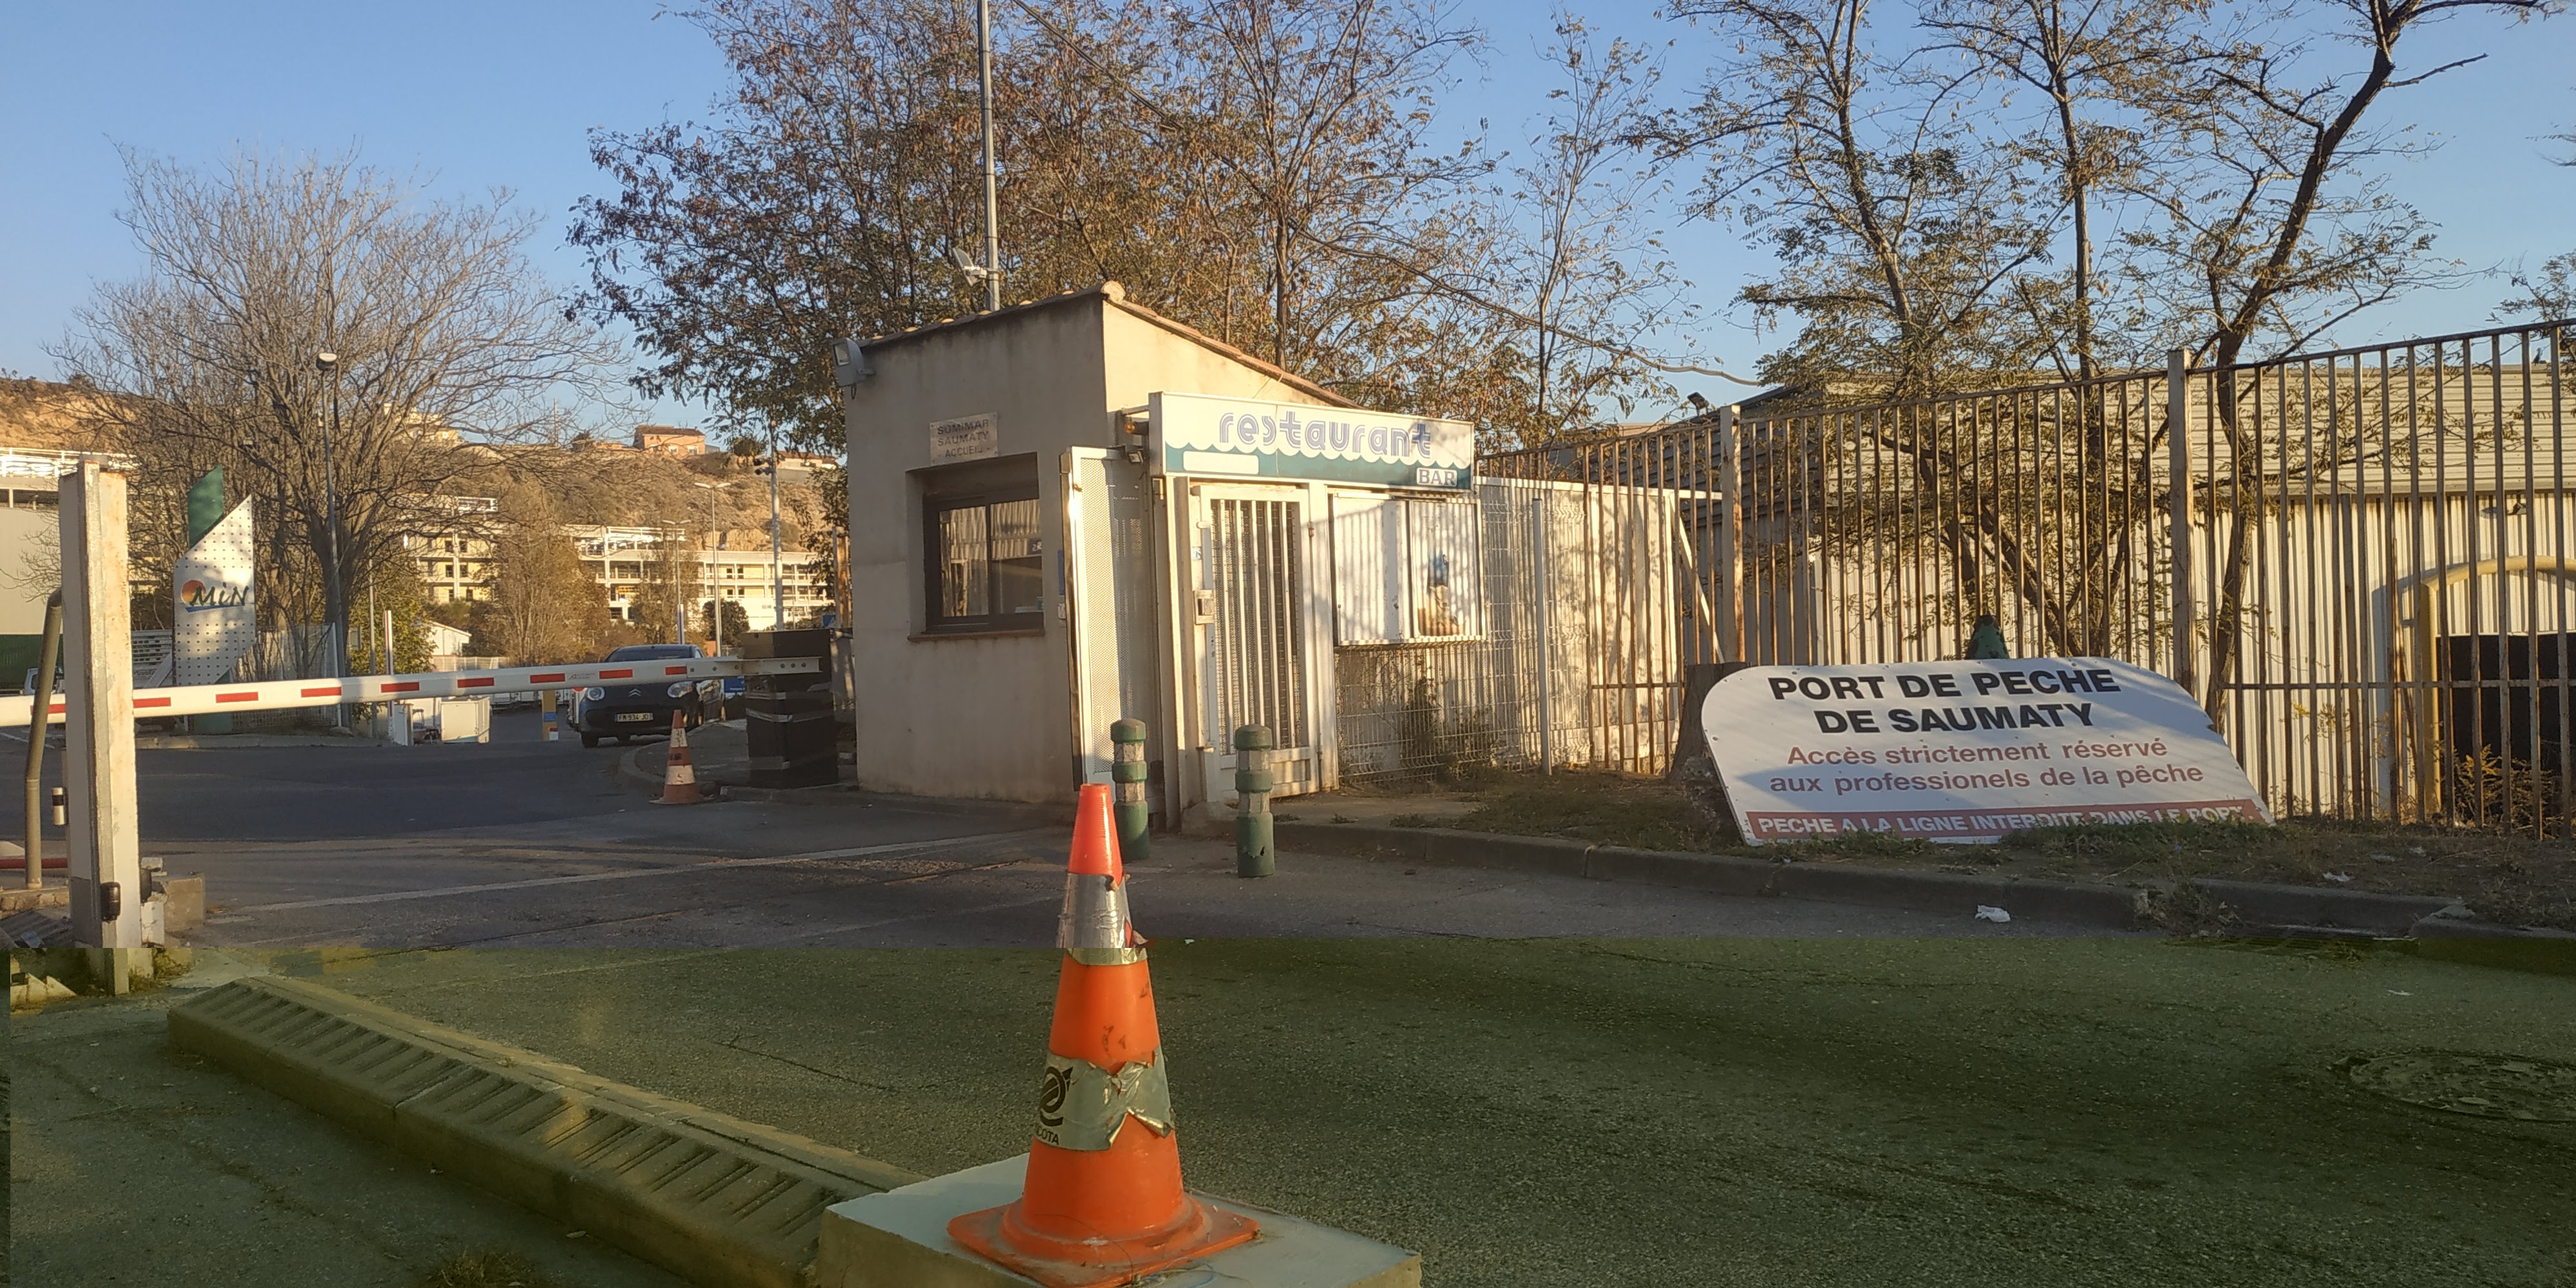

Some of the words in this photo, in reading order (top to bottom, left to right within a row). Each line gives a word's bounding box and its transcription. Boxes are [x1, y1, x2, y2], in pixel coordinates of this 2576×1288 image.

[937, 430, 989, 446] SAUMATY
[1219, 410, 1431, 459] restaurant
[945, 445, 983, 458] ACCUEIL
[1418, 468, 1456, 486] BAR
[1768, 676, 1885, 700] PORT
[1895, 674, 1962, 698] DE
[1970, 668, 2121, 696] PECHE
[1813, 710, 1880, 733] DE
[1888, 703, 2093, 733] SAUMATY
[1787, 746, 1877, 764] Accès
[1885, 742, 2050, 764] strictement
[2062, 737, 2168, 759] réservé
[1770, 777, 1823, 791] aux
[1835, 769, 2030, 795] professionels
[2040, 767, 2076, 786] de
[2082, 766, 2109, 784] la
[2116, 764, 2204, 788] pêche
[1757, 818, 1837, 833] PECHE
[1842, 817, 1858, 831] A
[1861, 817, 1892, 832] LA
[1897, 815, 1968, 832] LIGNE
[1969, 812, 2088, 830] INTERDITE
[2089, 809, 2152, 825] DANS
[2155, 808, 2181, 824] LE
